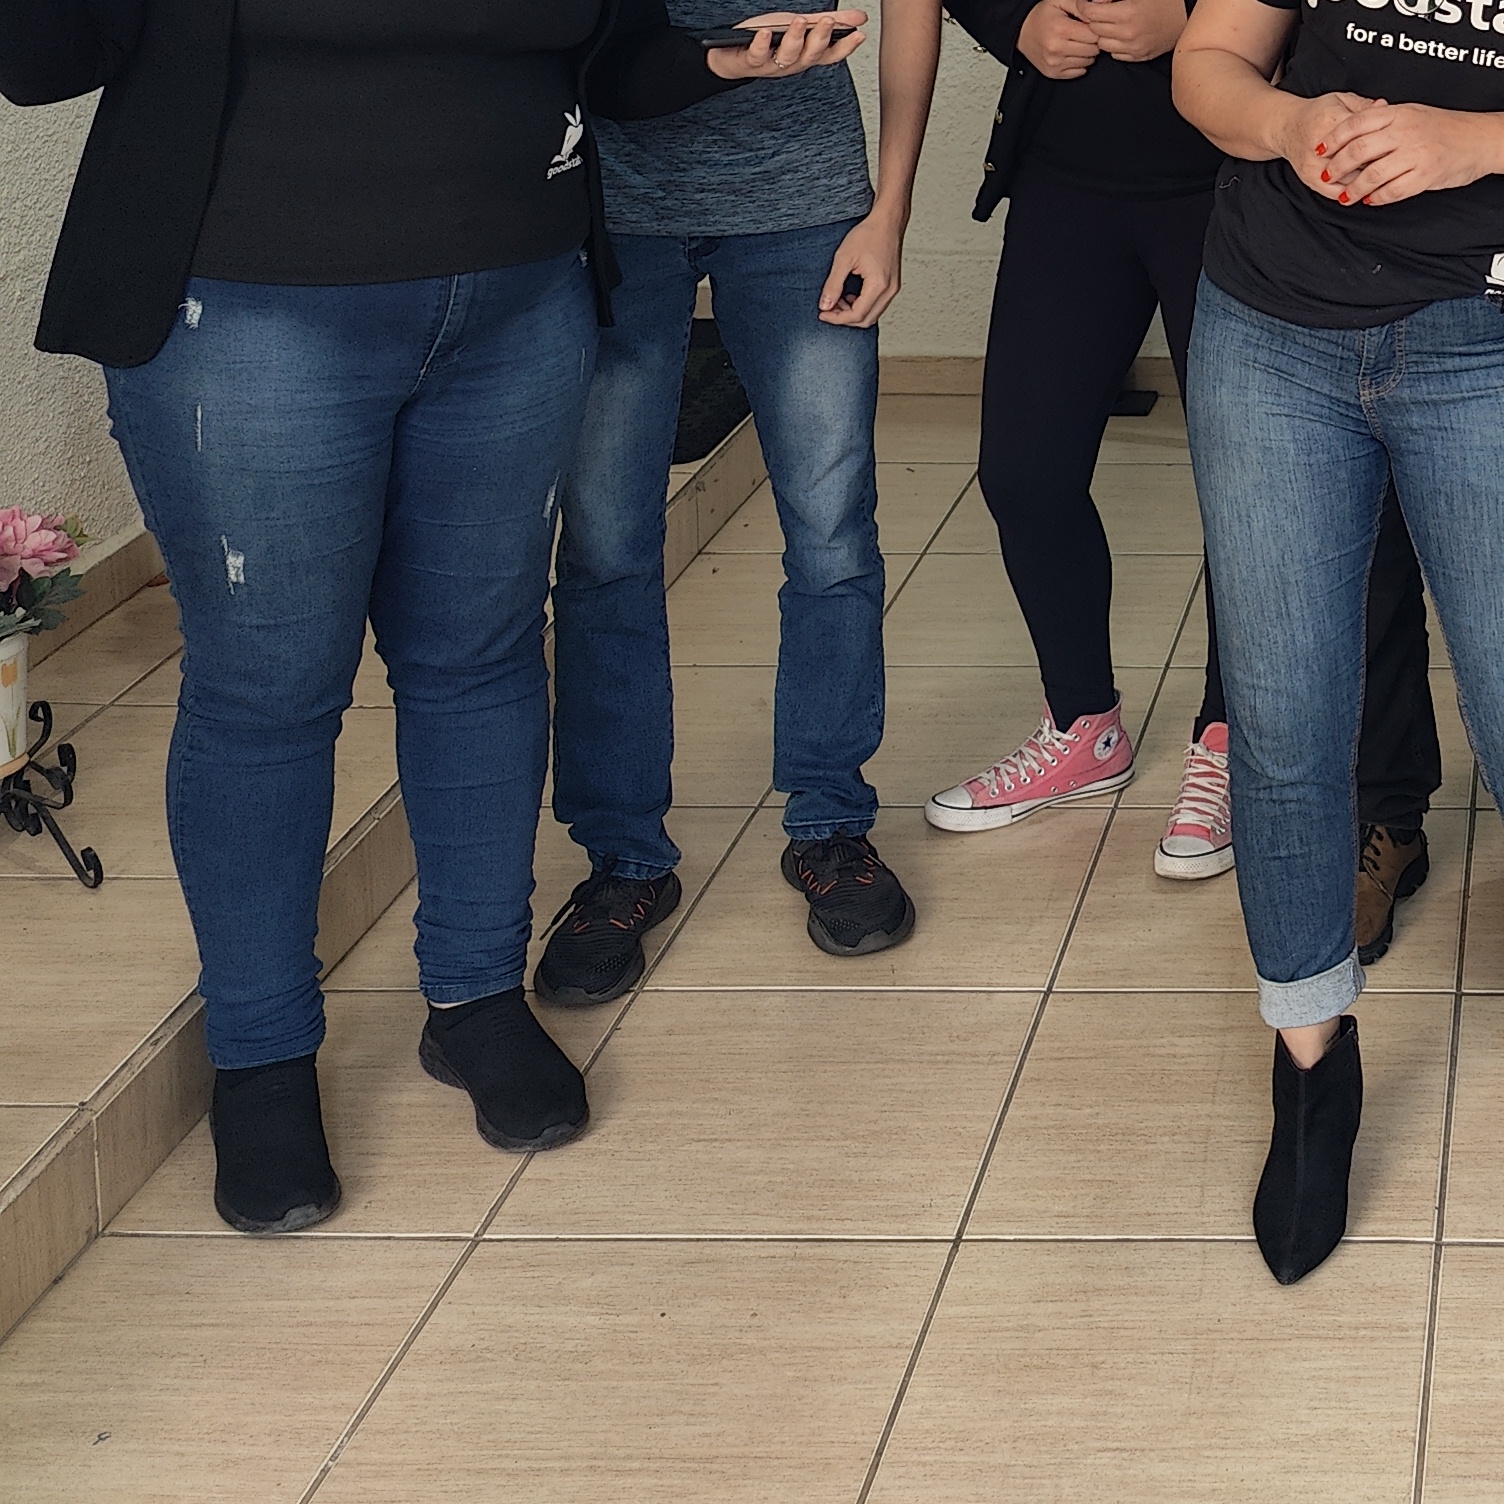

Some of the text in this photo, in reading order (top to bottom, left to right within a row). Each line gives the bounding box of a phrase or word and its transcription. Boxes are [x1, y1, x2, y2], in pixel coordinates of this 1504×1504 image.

[1346, 22, 1377, 43] for
[1380, 33, 1395, 48] a
[1398, 33, 1469, 62] better
